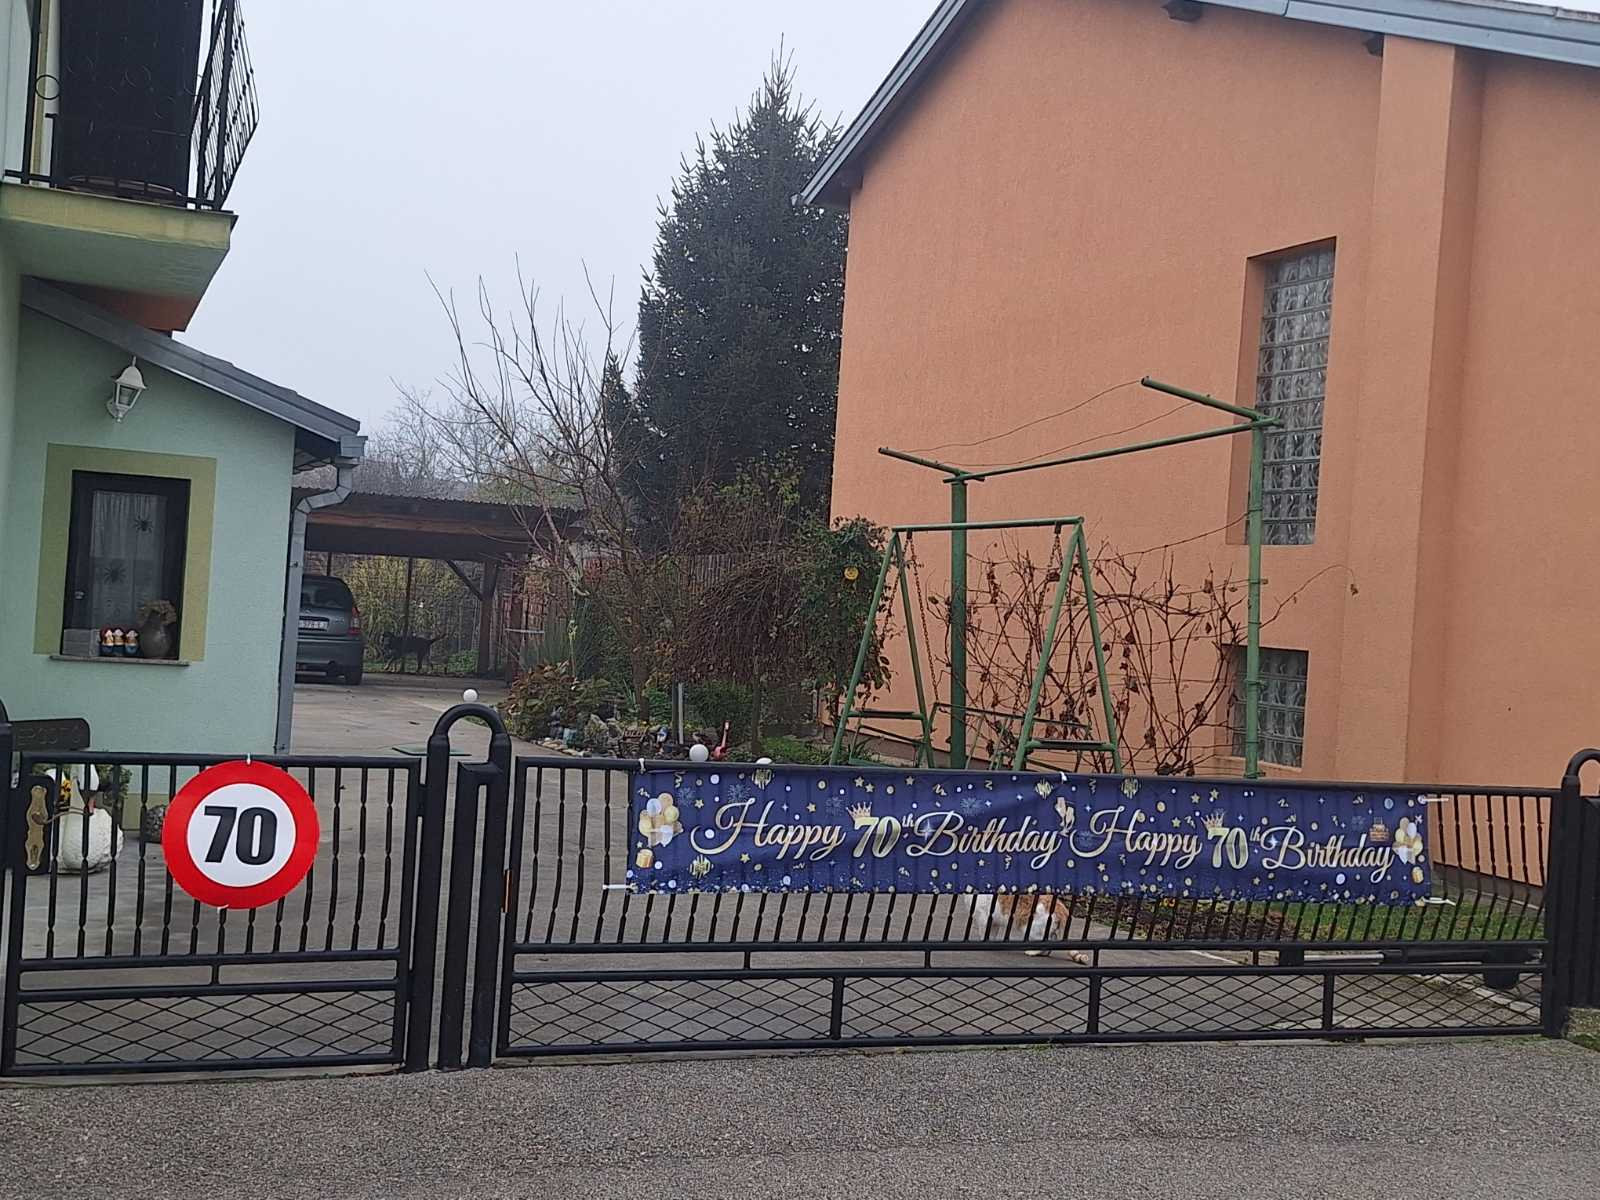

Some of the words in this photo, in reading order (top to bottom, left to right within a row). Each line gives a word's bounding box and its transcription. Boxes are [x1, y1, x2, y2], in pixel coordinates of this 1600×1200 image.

[203, 805, 278, 866] 70
[690, 798, 845, 861] Happy
[853, 813, 915, 858] 70th
[905, 811, 1062, 870] Birthday
[1070, 805, 1203, 869] Happy
[1207, 826, 1261, 869] 70th
[1261, 826, 1396, 883] Birthday
